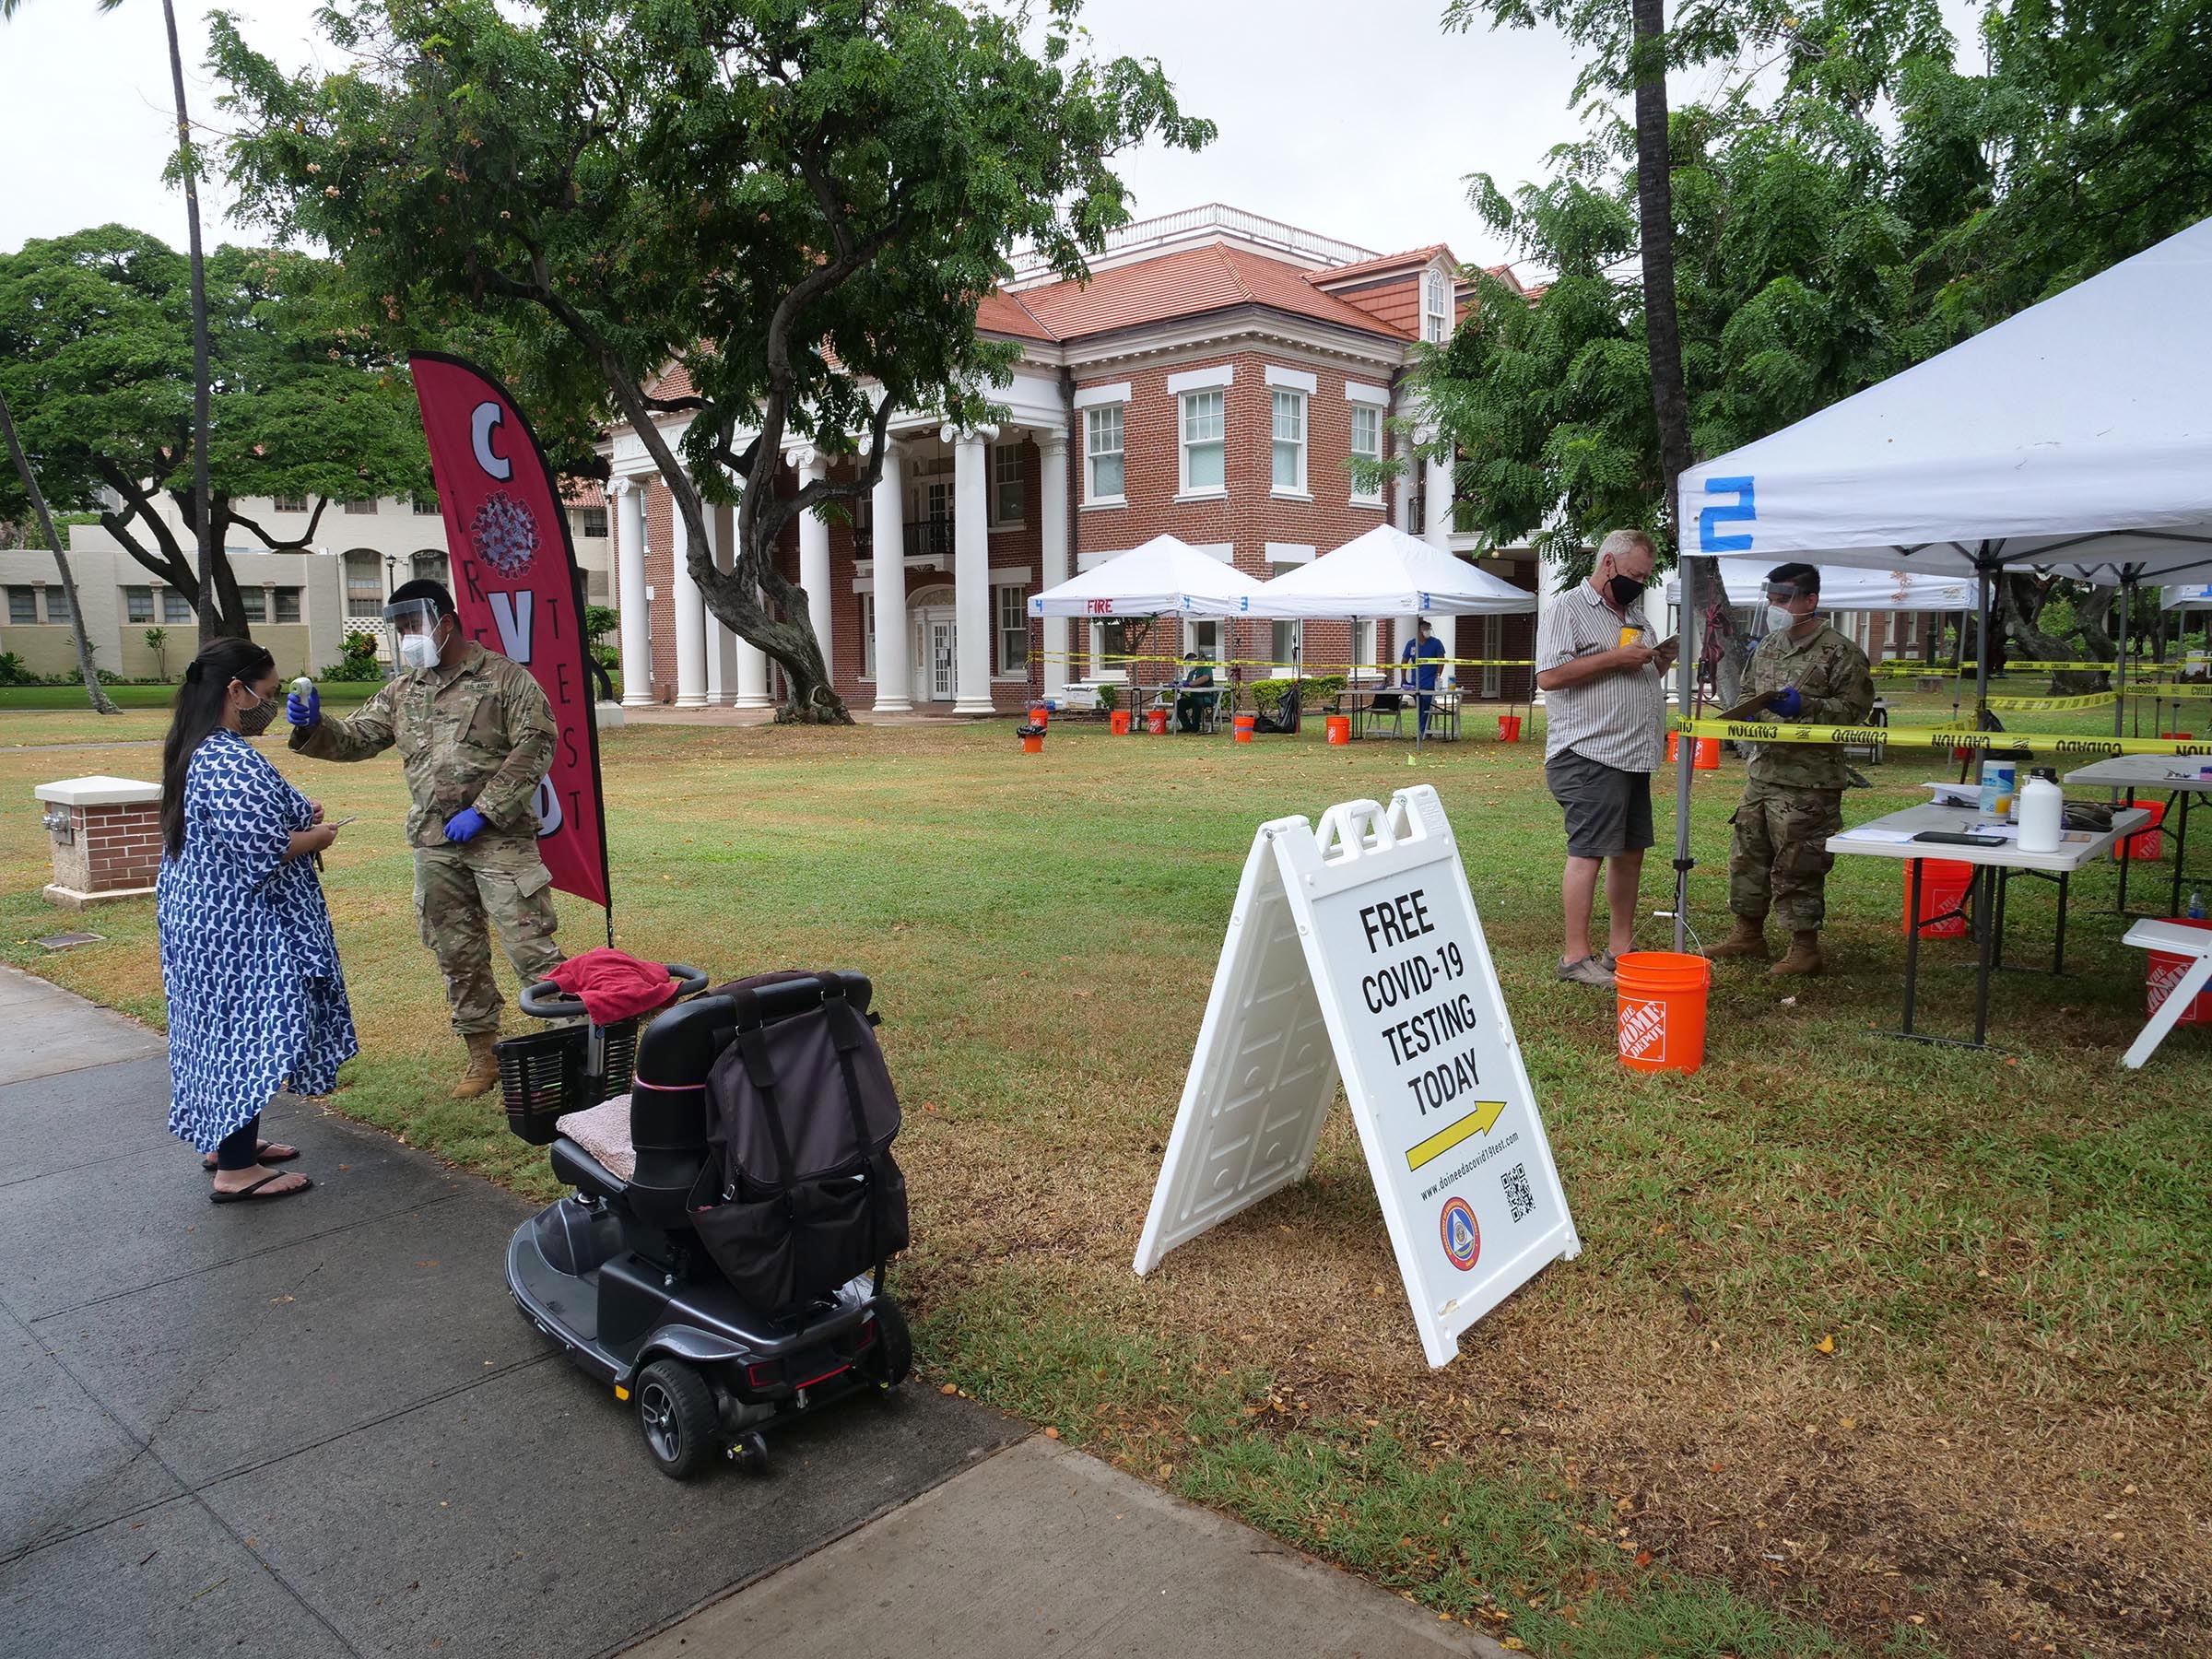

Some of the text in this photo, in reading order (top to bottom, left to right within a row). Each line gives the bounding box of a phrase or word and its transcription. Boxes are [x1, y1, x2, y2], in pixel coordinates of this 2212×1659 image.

[1700, 476, 1757, 553] 2
[1035, 599, 1042, 613] 4
[1088, 598, 1113, 614] FIRE
[1241, 596, 1248, 611] 3
[547, 599, 582, 830] TEST
[1728, 724, 1778, 739] CAUTION
[1831, 728, 1888, 745] CUIDADO
[1931, 734, 1991, 749] CAUTION
[1359, 888, 1435, 955] FREE
[1361, 941, 1465, 1015] COVID-19
[1382, 993, 1477, 1066] TESTING
[1619, 1002, 1665, 1054] HOME
[1620, 1004, 1637, 1027] THE
[1630, 1023, 1665, 1057] DEPOT
[1407, 1047, 1481, 1117] TODAY
[1420, 1132, 1519, 1202] www.doineedacovid19test.com
